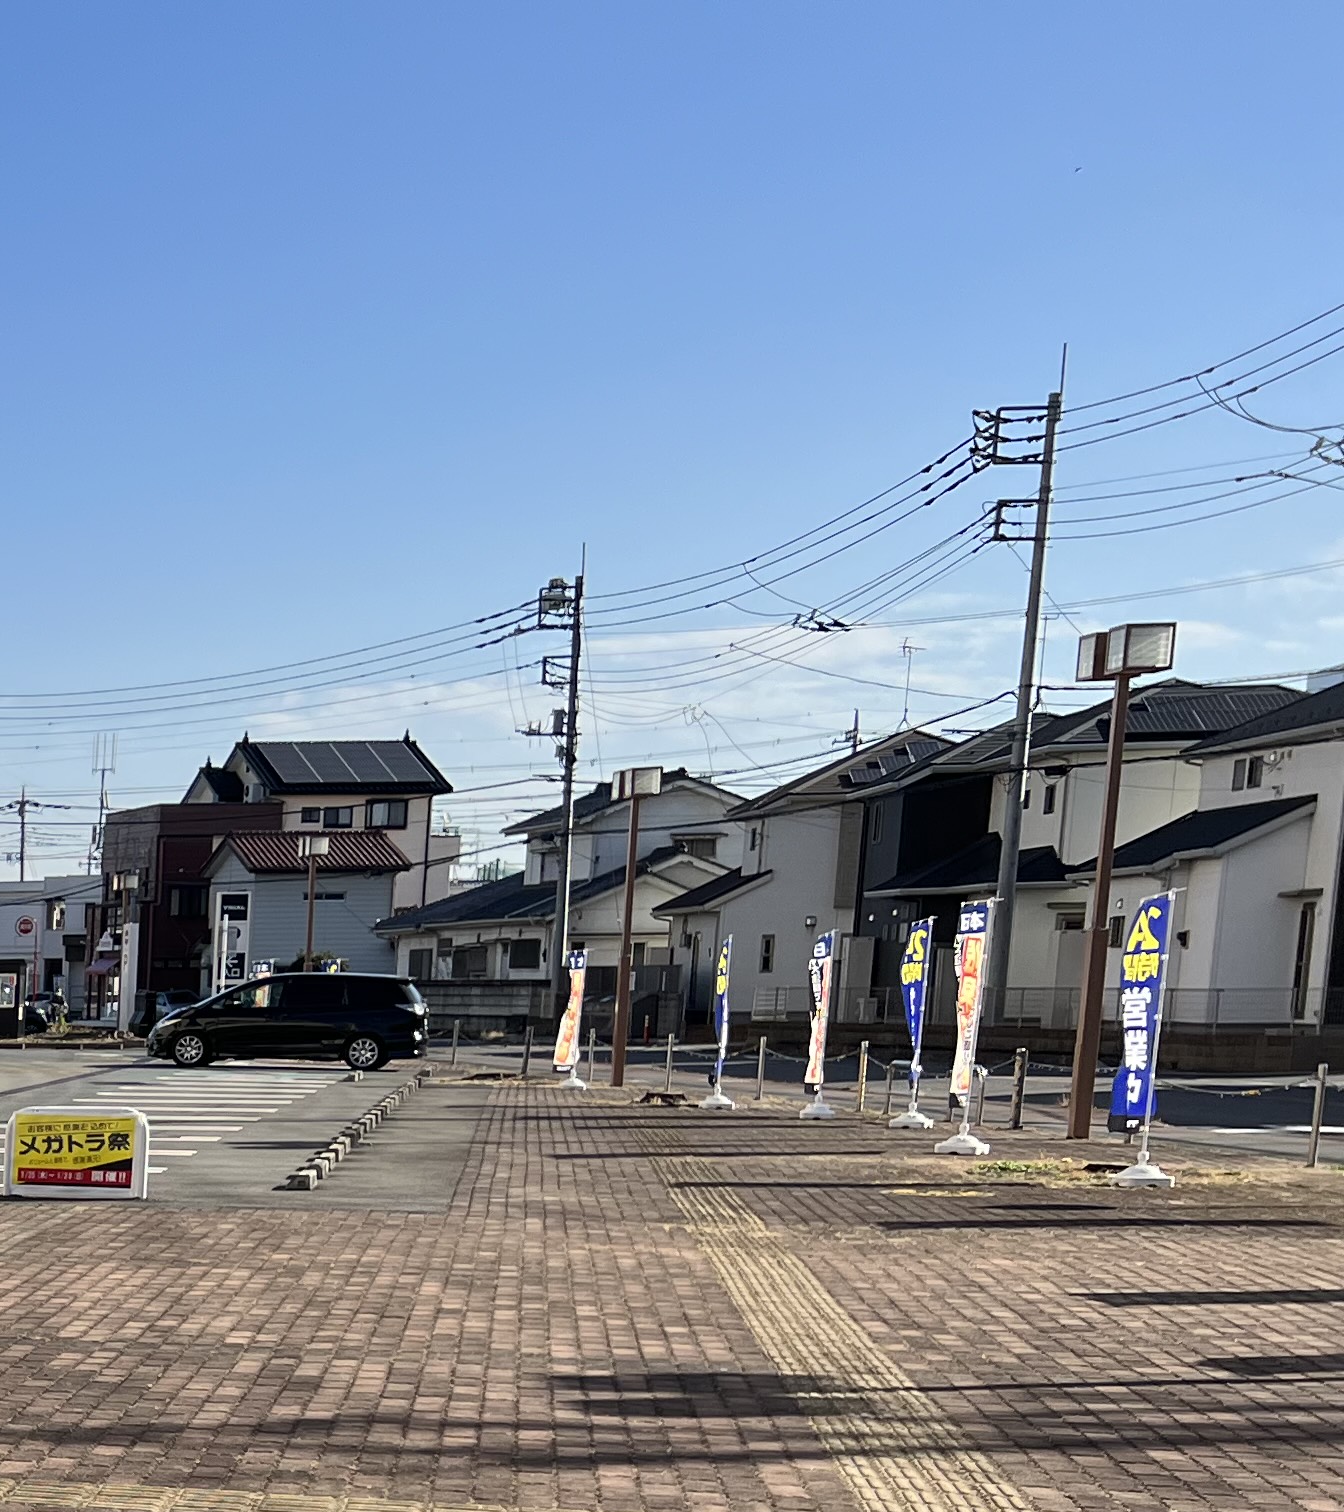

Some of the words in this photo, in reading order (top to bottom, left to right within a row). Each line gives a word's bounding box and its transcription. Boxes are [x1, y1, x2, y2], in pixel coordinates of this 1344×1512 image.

[18, 1132, 131, 1155] メガトラ祭
